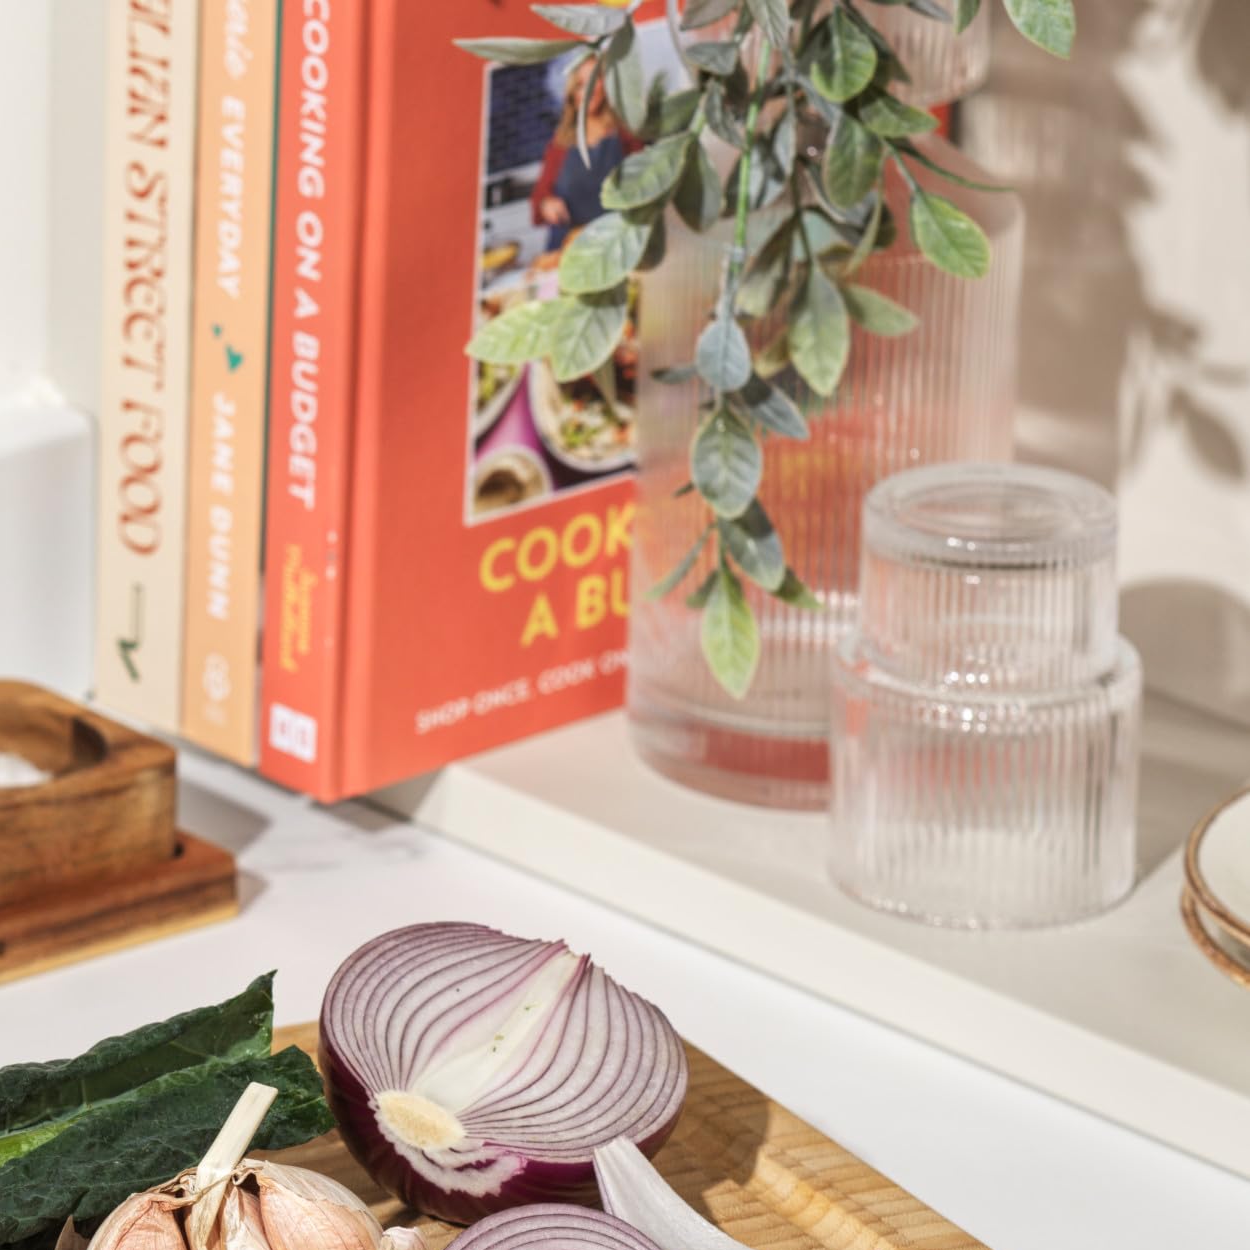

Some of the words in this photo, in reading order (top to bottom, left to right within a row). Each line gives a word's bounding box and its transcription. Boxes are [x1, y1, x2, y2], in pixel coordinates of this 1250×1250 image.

[299, 0, 331, 199] COOKING
[217, 96, 246, 299] EVERYDAY
[296, 211, 324, 281] ON
[294, 287, 320, 318] A
[117, 399, 163, 556] FOOD
[211, 392, 237, 495] JANE
[288, 331, 320, 510] BUDGET
[207, 505, 233, 620] DUNN
[520, 592, 558, 648] A
